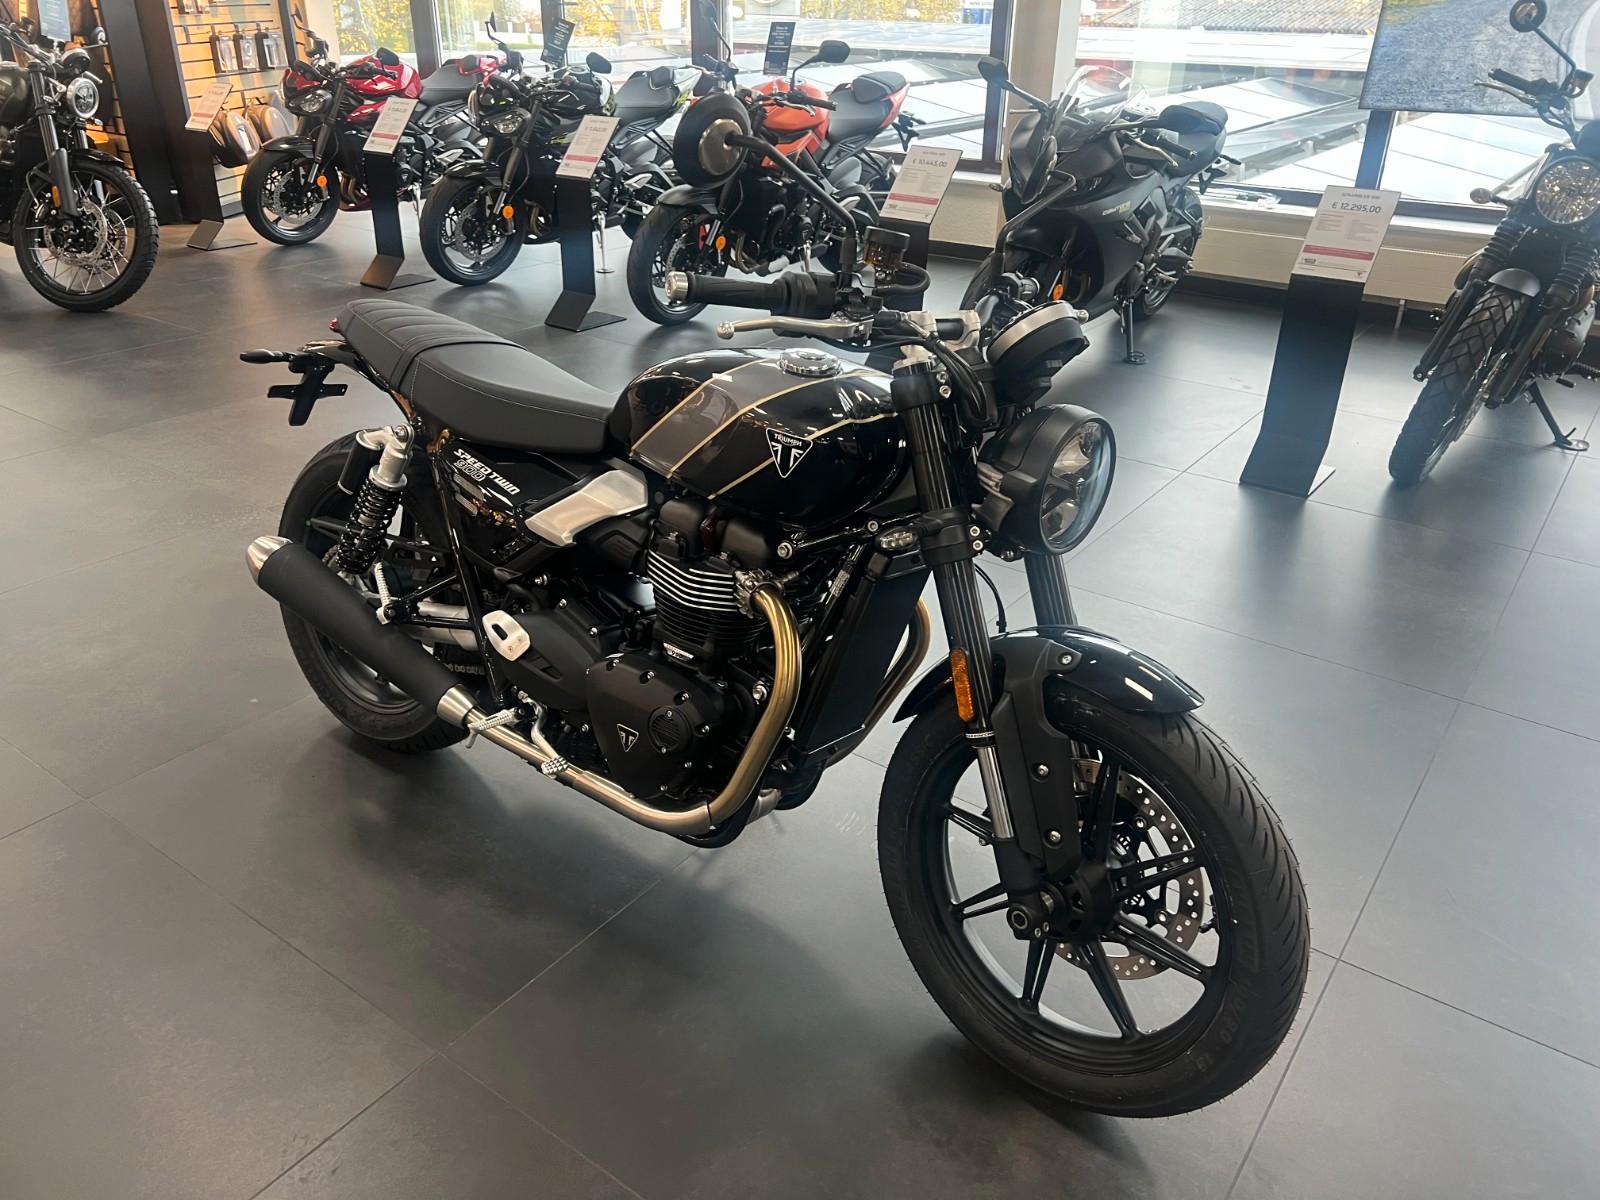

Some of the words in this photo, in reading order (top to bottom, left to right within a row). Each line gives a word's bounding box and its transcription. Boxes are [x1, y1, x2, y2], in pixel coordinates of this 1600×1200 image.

[774, 433, 802, 447] TRIUMPH
[453, 459, 486, 482] 900
[453, 448, 492, 475] SPEED
[489, 471, 521, 496] TWIN
